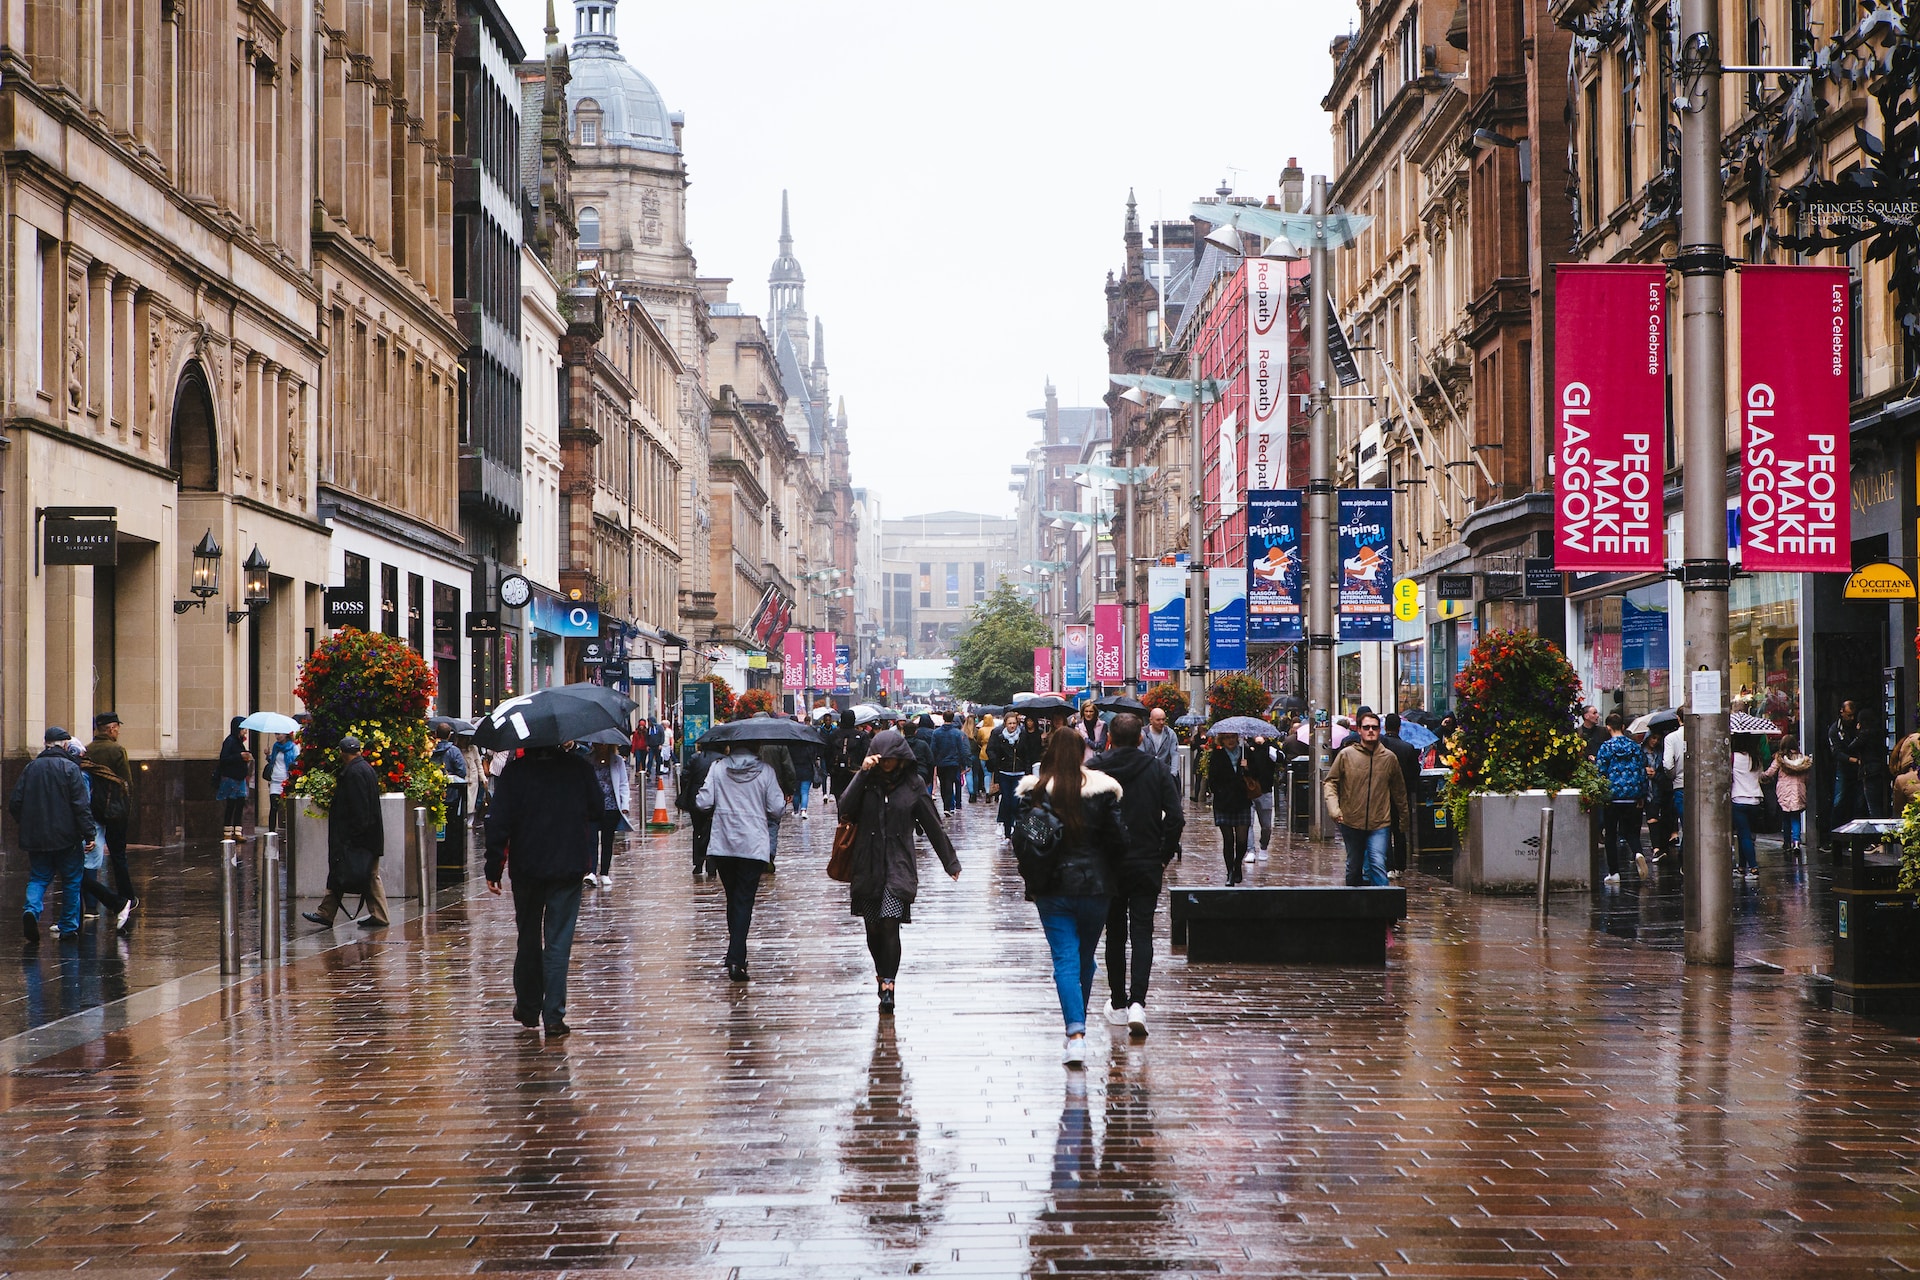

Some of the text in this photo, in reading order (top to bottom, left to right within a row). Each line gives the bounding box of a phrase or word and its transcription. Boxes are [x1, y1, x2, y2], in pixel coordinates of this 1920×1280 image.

[1809, 202, 1919, 219] PRINCES SQUARE
[1811, 214, 1869, 226] SHOPPING
[1255, 262, 1270, 323] Redpath
[1648, 282, 1661, 376] Let's Celebrate
[1832, 283, 1844, 377] Let's Celebrate
[1255, 350, 1271, 412] Redpath
[1562, 381, 1591, 554] GLASGOW
[1747, 383, 1775, 554] GLASGOW
[1250, 500, 1298, 508] www.pipinglive.co.uk
[1341, 500, 1389, 508] www.pipinglive.co.uk
[1592, 458, 1621, 554] MAKE
[1622, 433, 1650, 554] PEOPLE
[1808, 434, 1836, 555] PEOPLE
[1853, 469, 1896, 515] SQUARE
[1777, 459, 1806, 555] MAKE
[50, 535, 109, 543] TED BAKER
[1248, 523, 1290, 539] Piping
[1263, 527, 1296, 549] Live!
[1339, 522, 1380, 538] Piping
[1355, 526, 1387, 548] Live!
[1442, 580, 1467, 588] Russell
[1851, 578, 1912, 589] L'OCCITANE
[332, 601, 364, 611] BOSS
[1095, 633, 1104, 677] GLASGOW
[1103, 652, 1111, 677] MAKE
[1111, 645, 1119, 677] PEOPLE
[1141, 633, 1150, 677] GLASGOW
[1514, 849, 1526, 857] the
